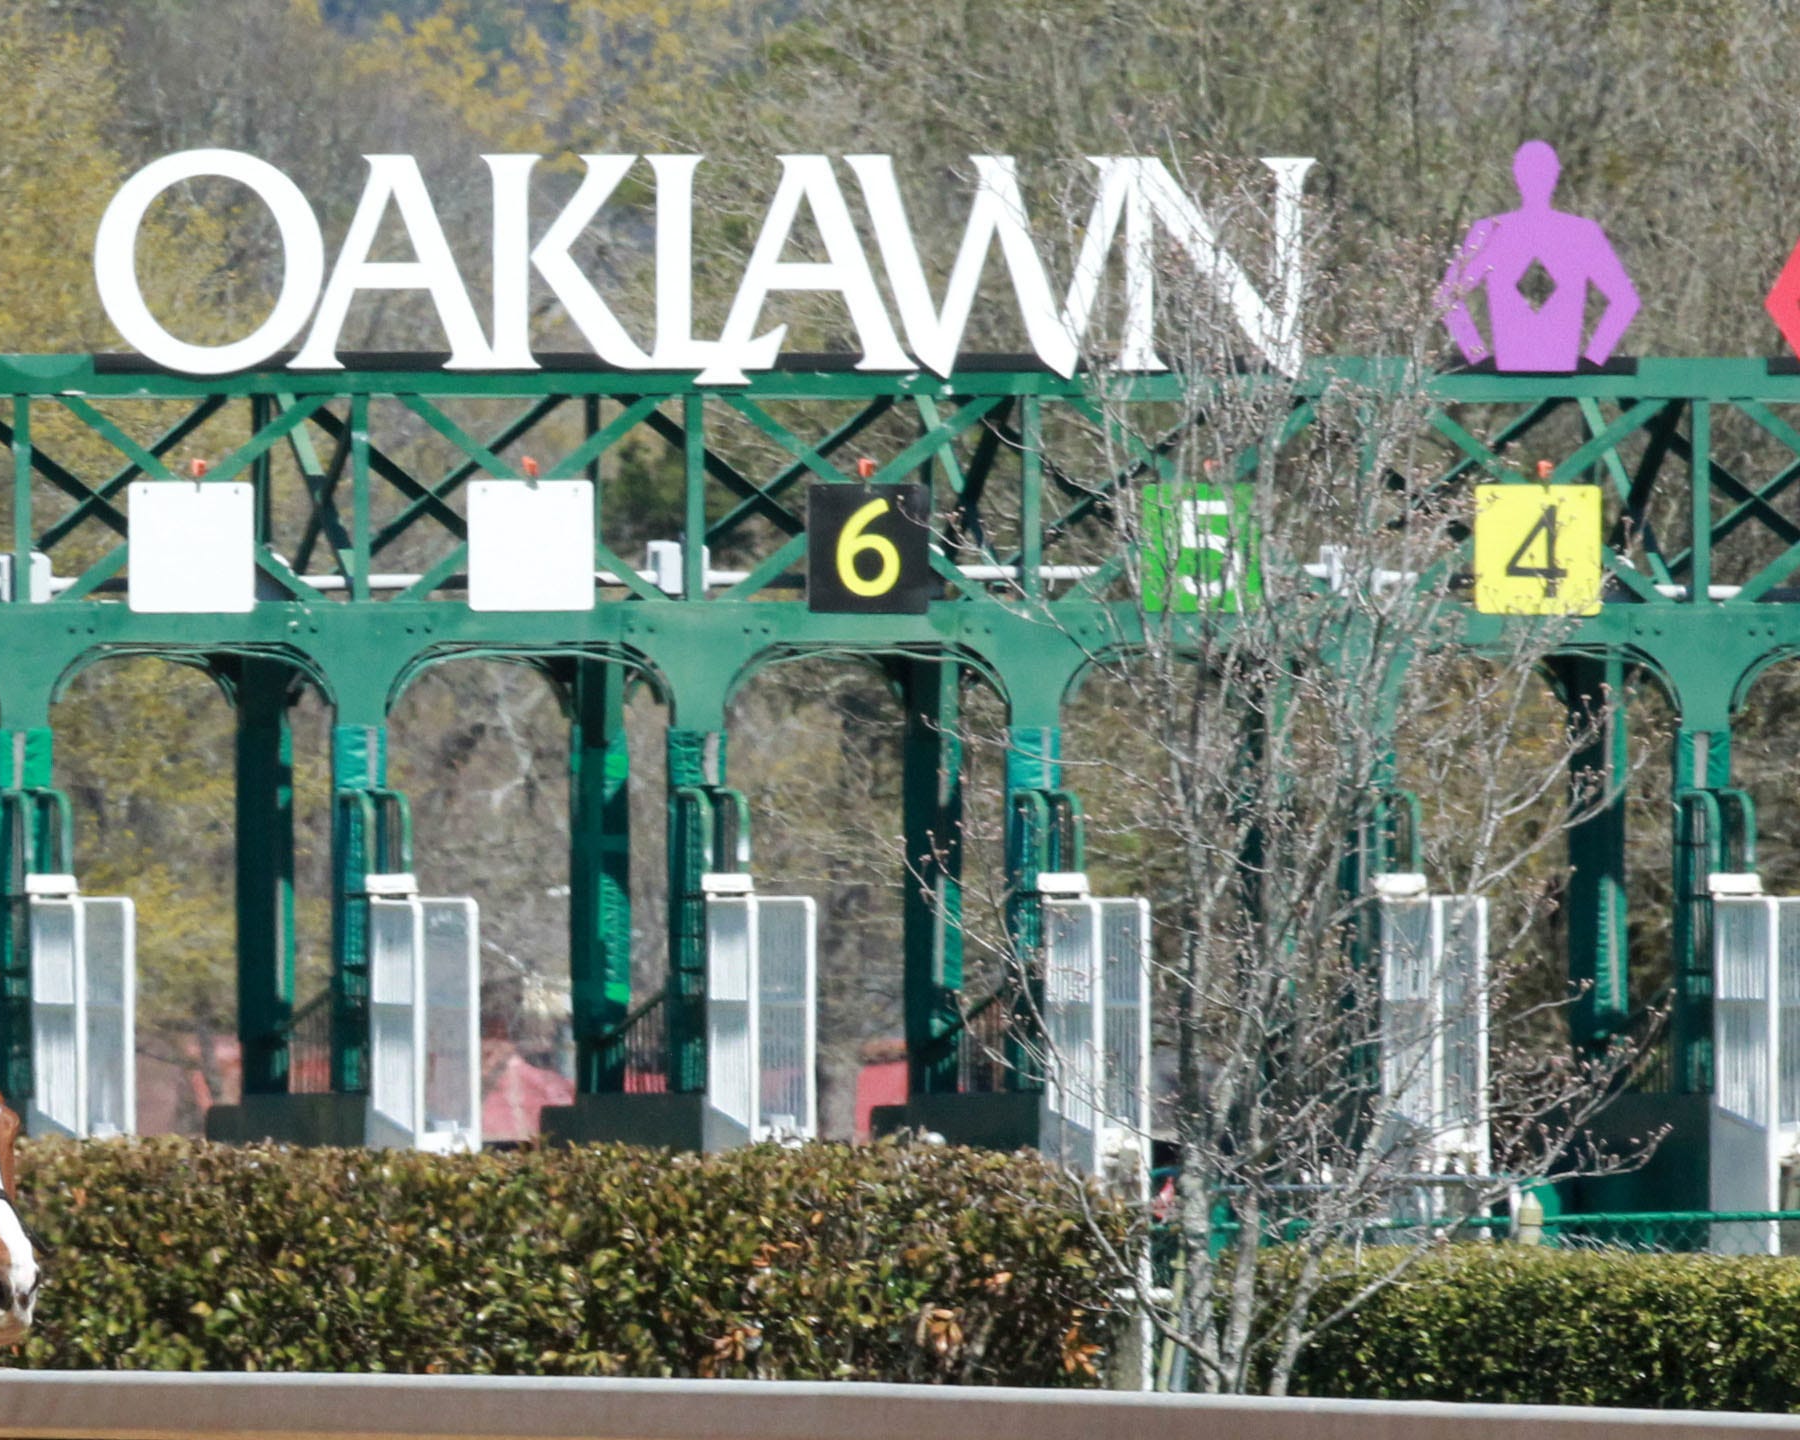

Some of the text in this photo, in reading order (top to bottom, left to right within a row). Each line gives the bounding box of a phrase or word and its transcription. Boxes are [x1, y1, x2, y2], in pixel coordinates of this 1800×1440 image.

[94, 148, 1317, 385] OAKLAWN
[836, 498, 900, 597] 6
[1180, 499, 1242, 598] 5
[1505, 504, 1568, 599] 4
